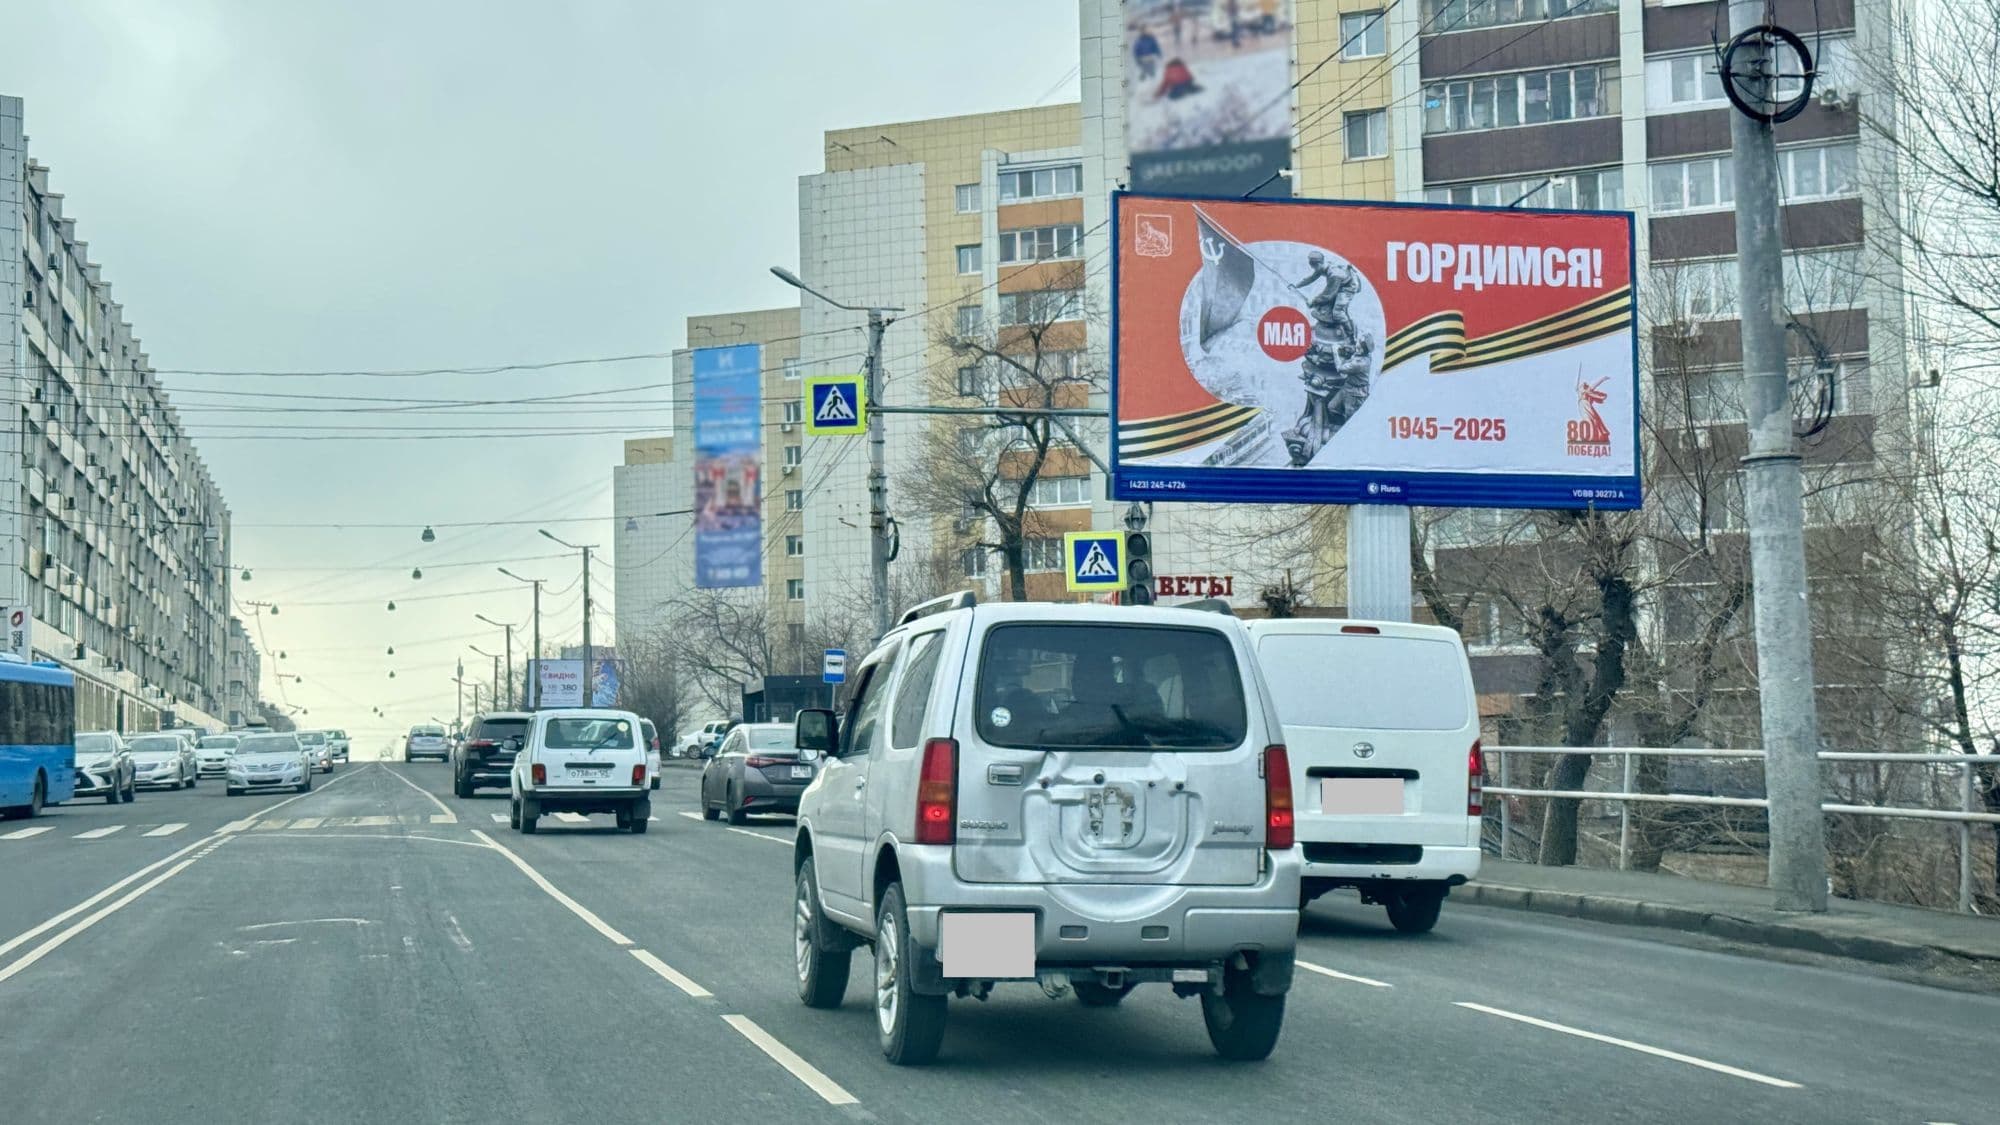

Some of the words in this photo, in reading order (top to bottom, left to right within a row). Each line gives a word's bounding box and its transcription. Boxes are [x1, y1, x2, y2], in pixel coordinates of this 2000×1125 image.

[1386, 241, 1603, 290] ГОРДИМСЯ!
[1263, 323, 1306, 348] МАЯ
[1567, 420, 1591, 442] 80
[1568, 445, 1611, 458] ПОБЕДА!
[1380, 484, 1401, 493] Russ
[1617, 490, 1625, 499] A
